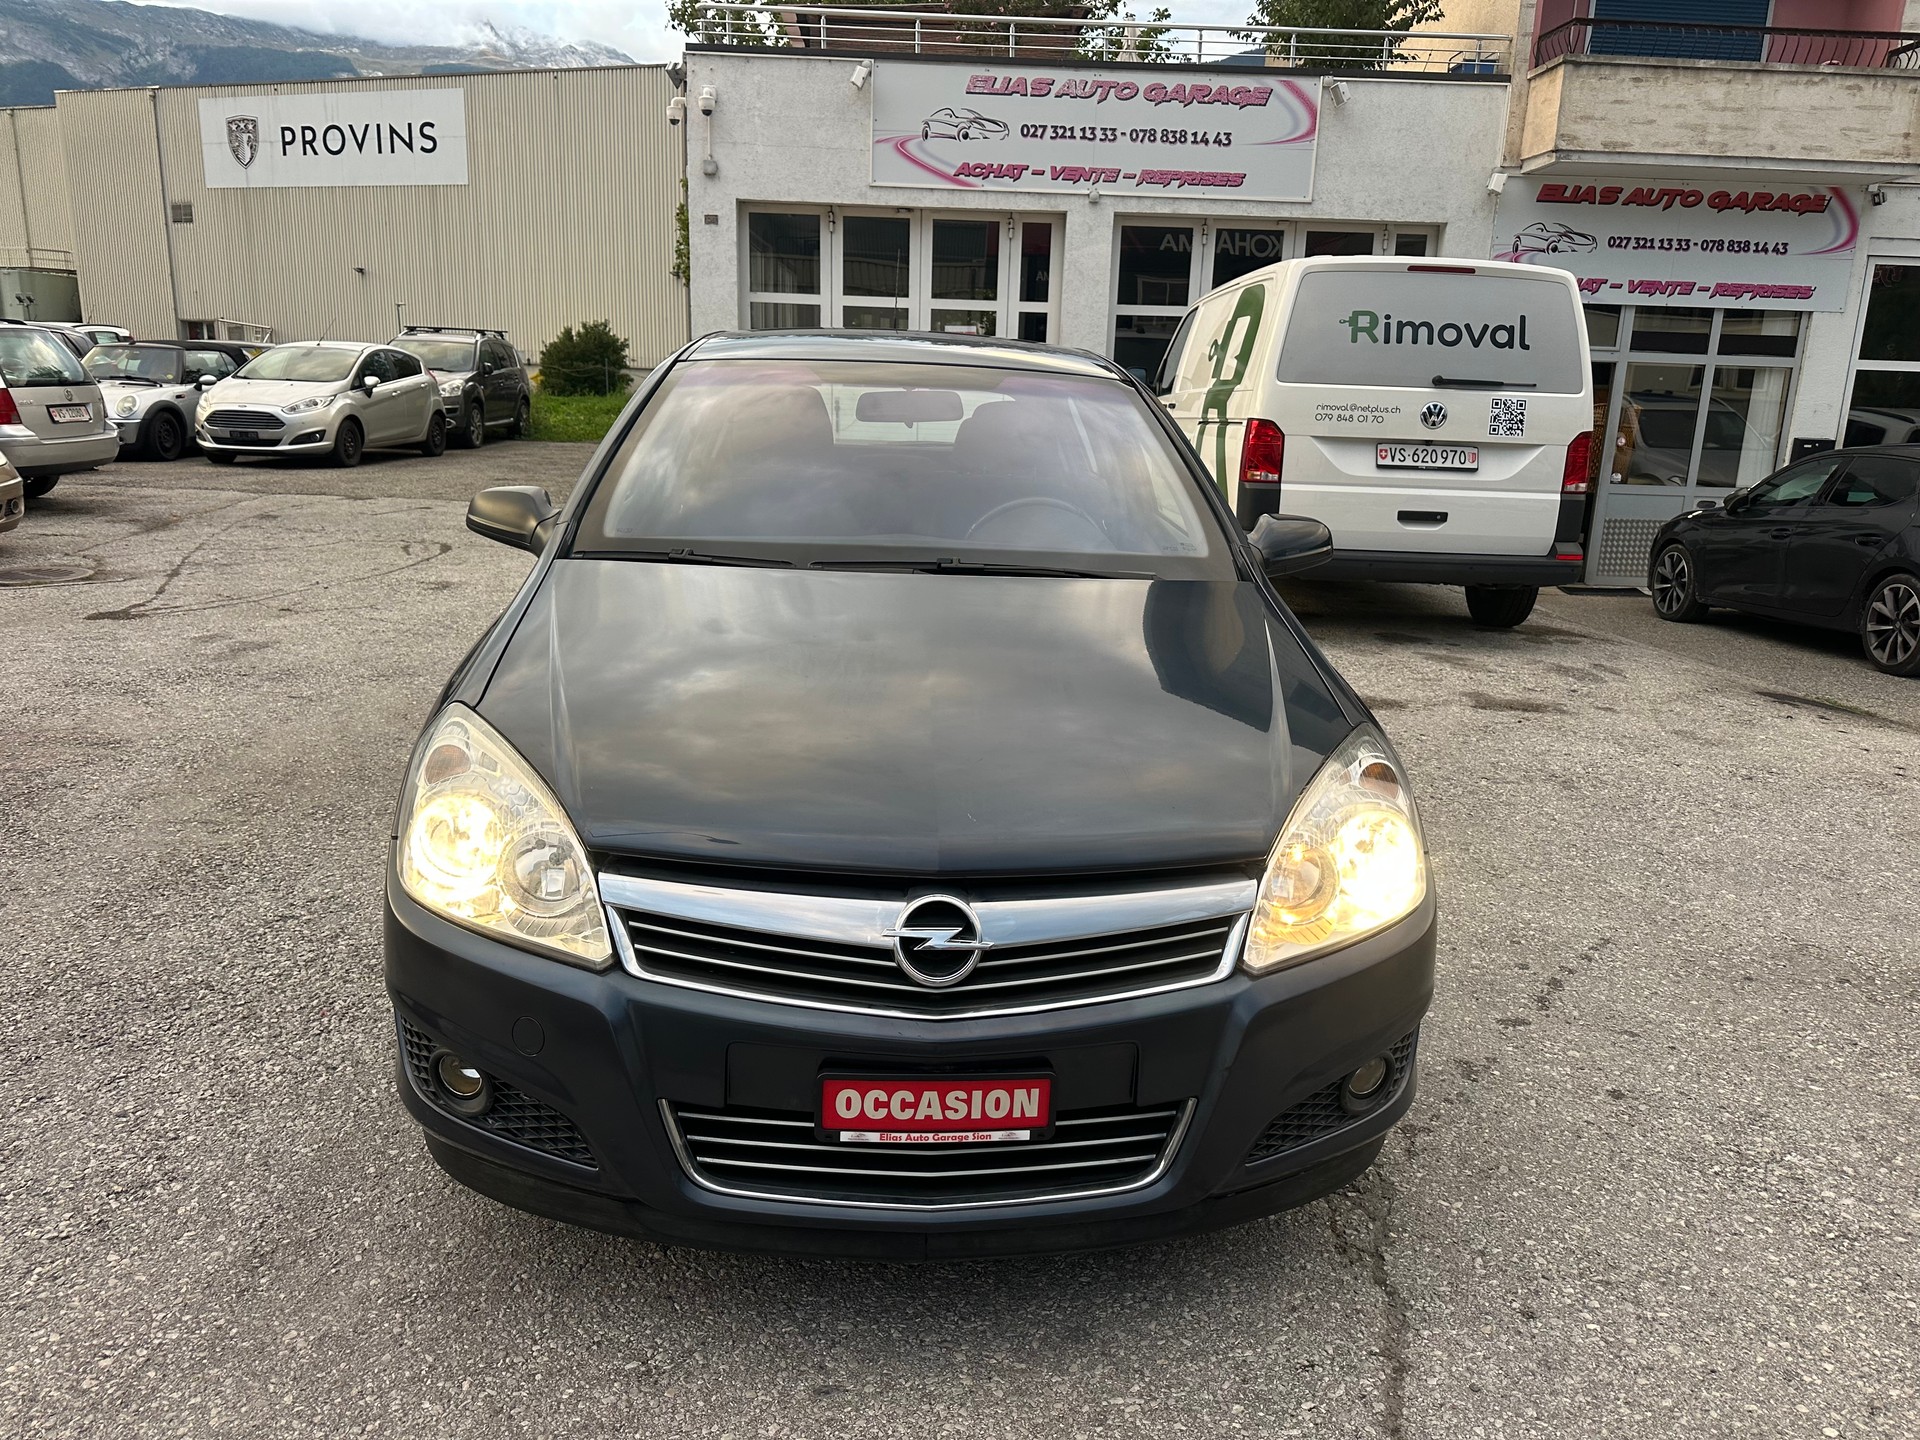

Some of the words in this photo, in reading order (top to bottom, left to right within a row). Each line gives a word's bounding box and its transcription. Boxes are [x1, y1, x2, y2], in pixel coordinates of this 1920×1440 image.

[966, 75, 1055, 97] ELIAS
[1054, 80, 1139, 104] AUTO
[1143, 83, 1273, 110] GARAGE
[280, 122, 438, 156] PROVINS
[1020, 124, 1047, 139] 027
[1050, 125, 1076, 140] 321
[1079, 126, 1097, 141] 13
[1099, 127, 1117, 142] 33
[1129, 128, 1157, 144] 078
[1160, 129, 1187, 145] 838
[1190, 131, 1209, 146] 14
[1212, 132, 1232, 147] 43
[953, 162, 1030, 182] ACHAT
[1049, 165, 1121, 186] VENTE
[1135, 169, 1246, 188] REPRISES
[1536, 183, 1624, 205] ELIAS
[1621, 186, 1704, 212] AUTO
[1707, 192, 1833, 217] GARAGE
[1607, 235, 1631, 249] 027
[1632, 236, 1656, 250] 321
[1657, 237, 1673, 250] 13
[1674, 238, 1691, 251] 33
[1700, 239, 1725, 253] 078
[1726, 240, 1750, 254] 838
[1752, 241, 1769, 255] 14
[1771, 242, 1789, 256] 43
[1627, 278, 1696, 298] VENTE
[1709, 282, 1816, 301] REPRISES
[1340, 310, 1530, 350] Rimoval
[1315, 413, 1334, 421] 079
[1336, 413, 1354, 422] 848
[1357, 414, 1368, 423] 01
[1371, 415, 1384, 424] 70
[1316, 403, 1401, 414] rimoval@netplus.ch
[835, 1088, 1040, 1120] OCCASION
[879, 1133, 902, 1142] Elias
[905, 1133, 929, 1142] Auto
[932, 1133, 969, 1143] Garage
[972, 1132, 992, 1141] Sion
